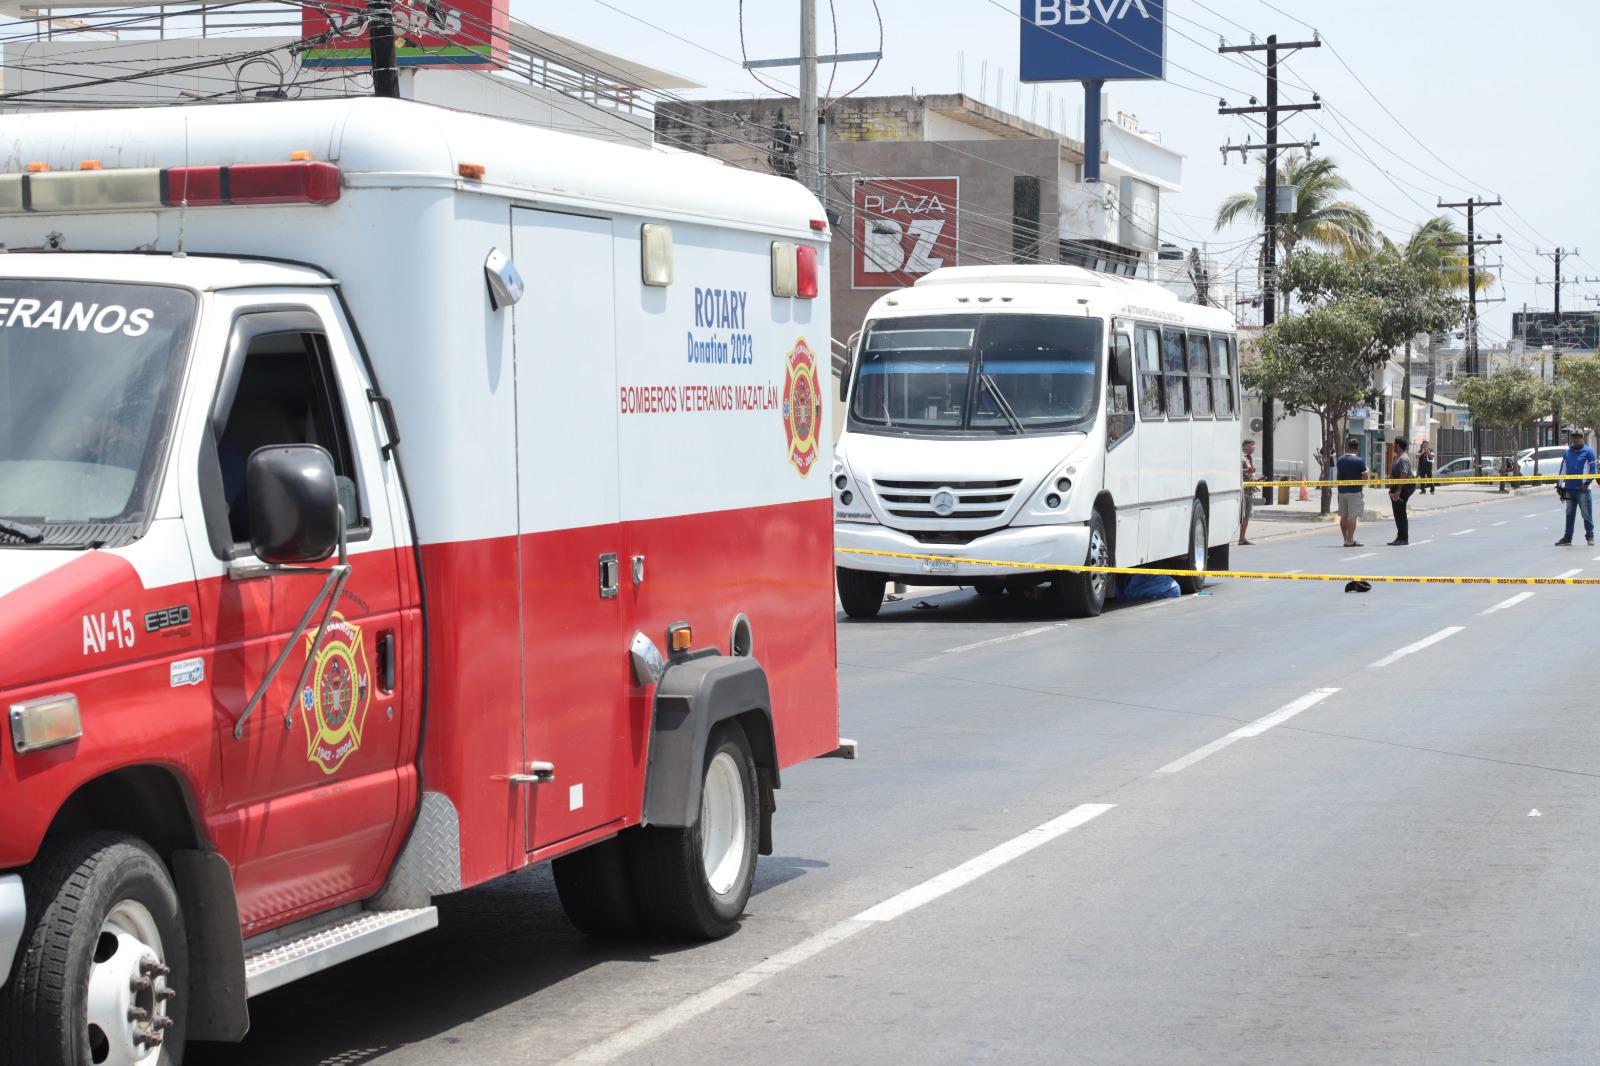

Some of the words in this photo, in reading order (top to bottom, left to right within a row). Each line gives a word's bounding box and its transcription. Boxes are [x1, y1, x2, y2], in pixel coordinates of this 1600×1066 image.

[1034, 0, 1151, 26] BBVA
[864, 194, 947, 214] PLAZA
[863, 219, 946, 273] BZ
[0, 297, 155, 337] ERANOS
[694, 287, 747, 329] ROTARY
[687, 331, 728, 364] Donation
[730, 333, 753, 365] 2023
[620, 386, 677, 414] BOMBEROS
[678, 385, 733, 412] VETERANOS
[734, 379, 779, 411] MAZATLÁN
[82, 608, 136, 656] AV-15
[145, 605, 191, 633] E350
